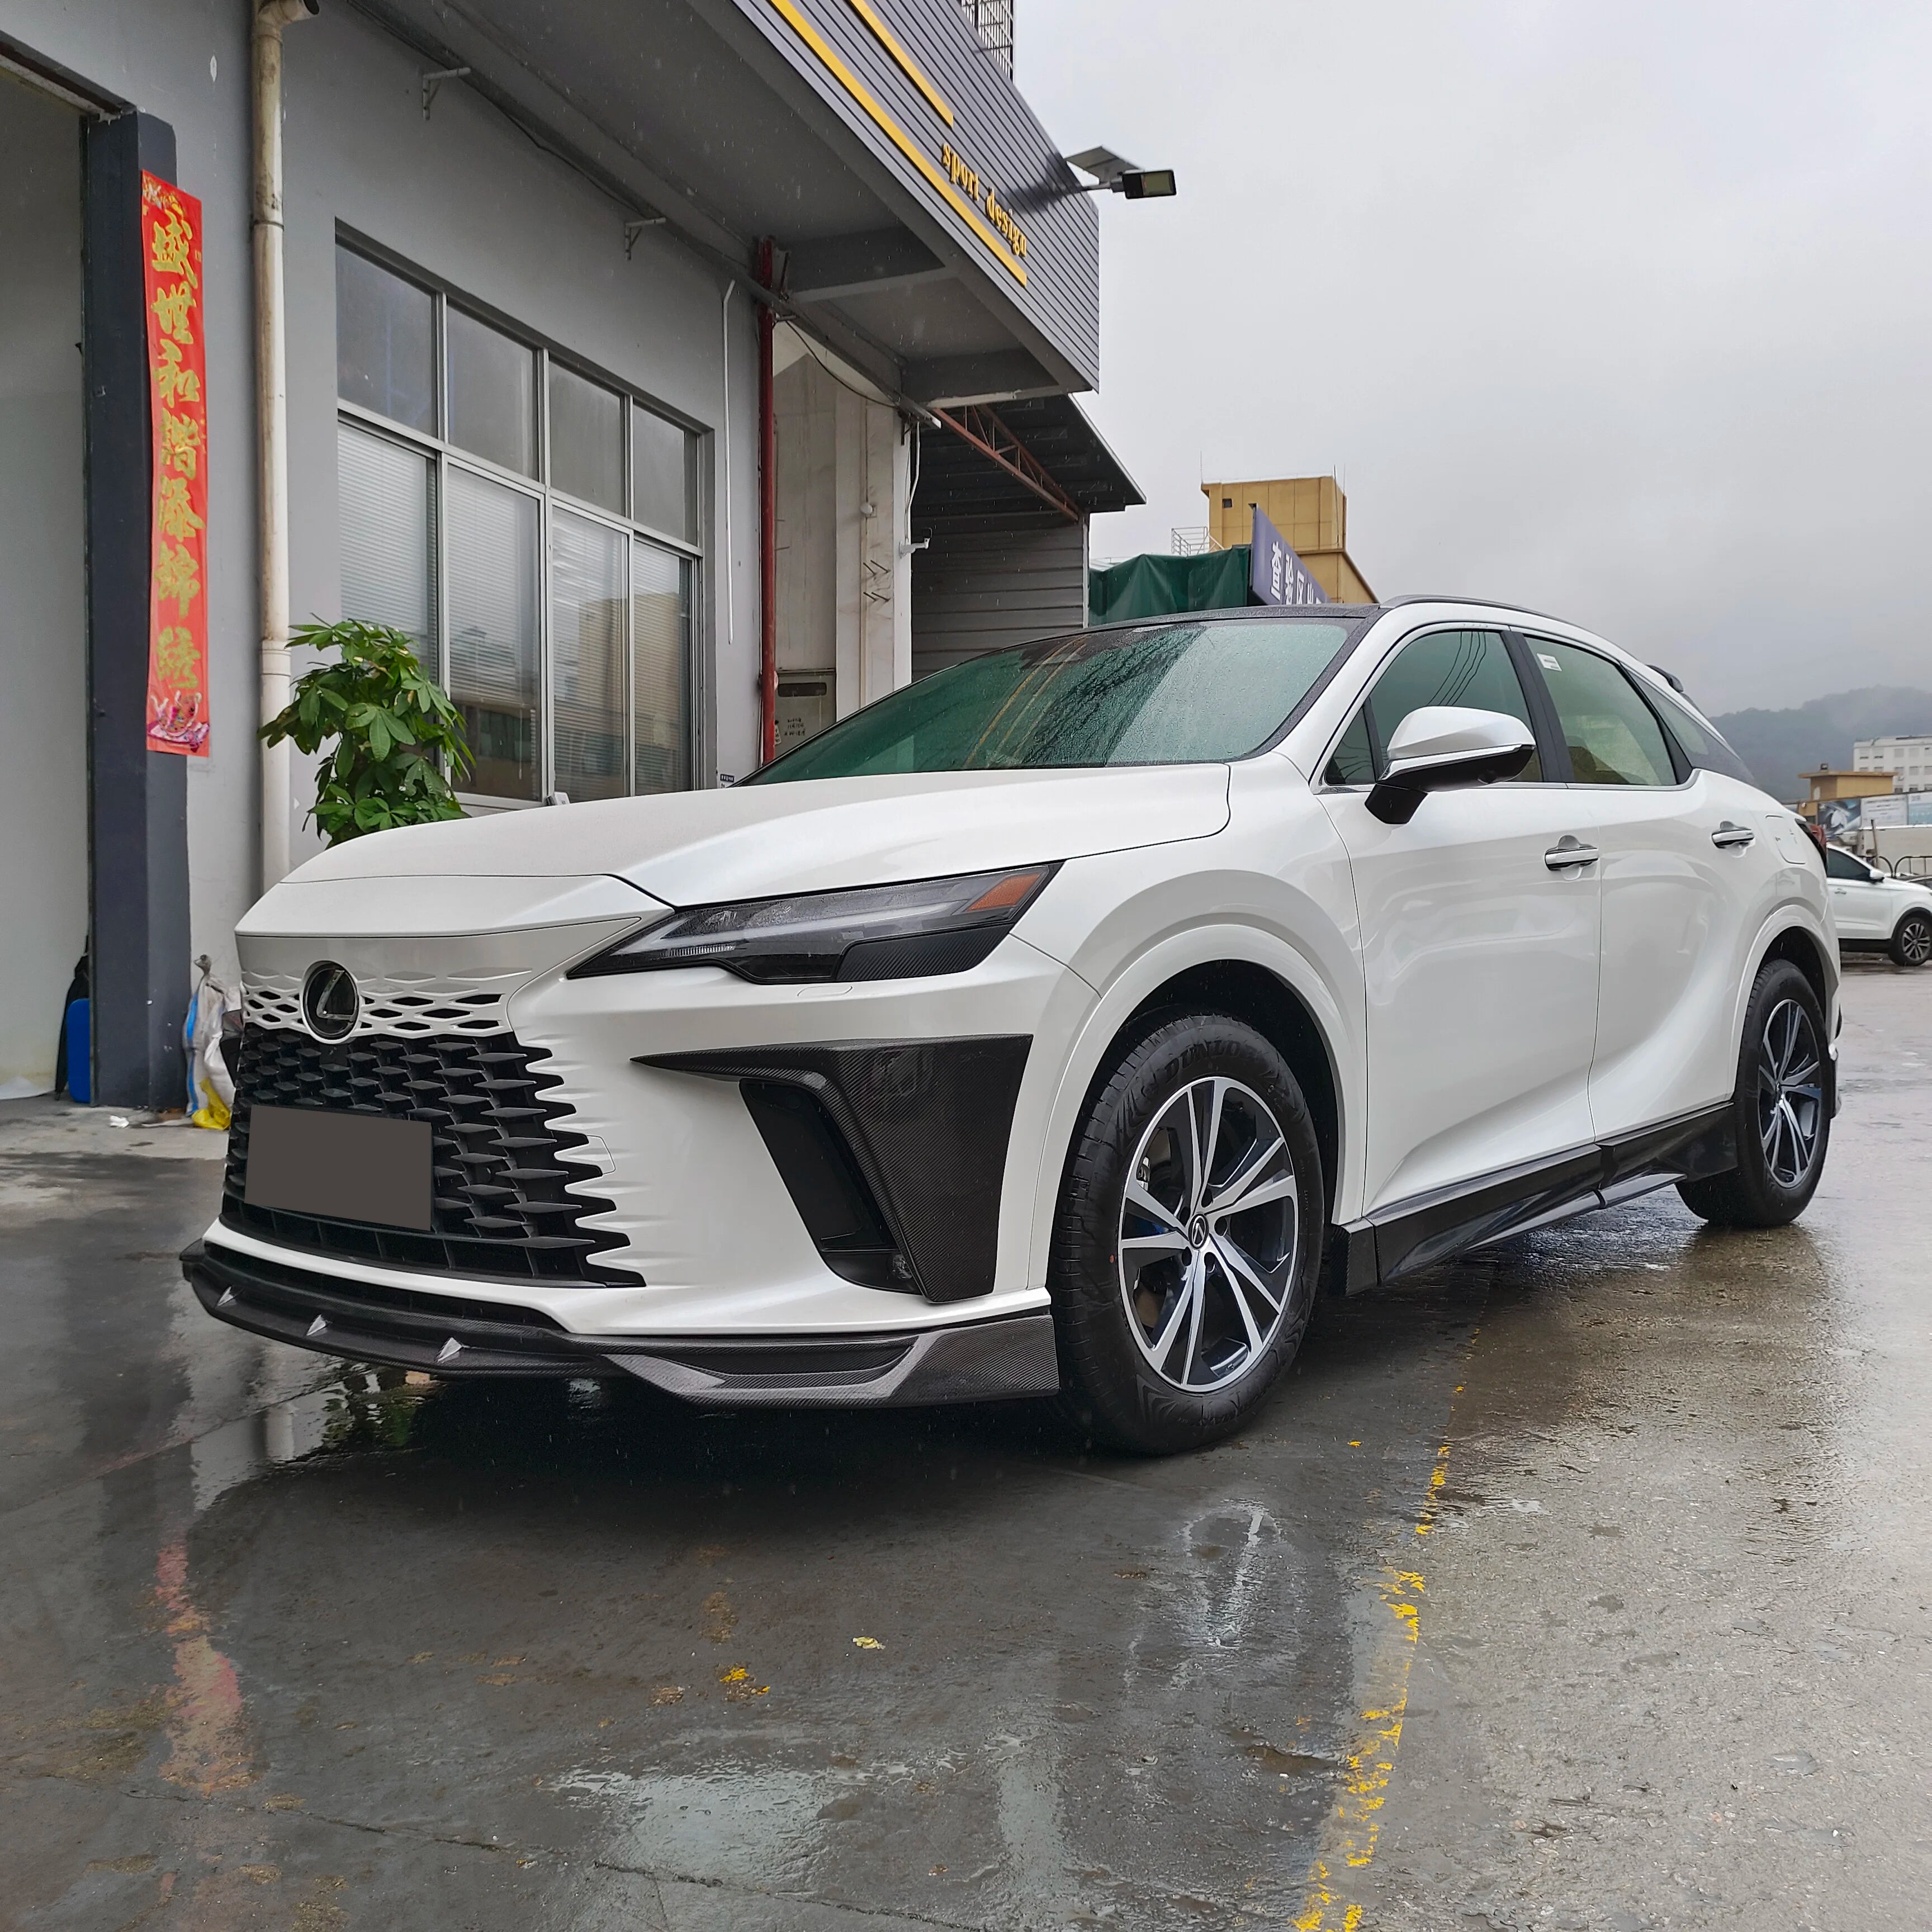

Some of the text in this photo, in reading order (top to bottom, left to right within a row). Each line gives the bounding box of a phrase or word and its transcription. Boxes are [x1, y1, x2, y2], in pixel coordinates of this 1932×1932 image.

[942, 143, 1027, 257] sport design
[1271, 541, 1322, 605] 查验区
